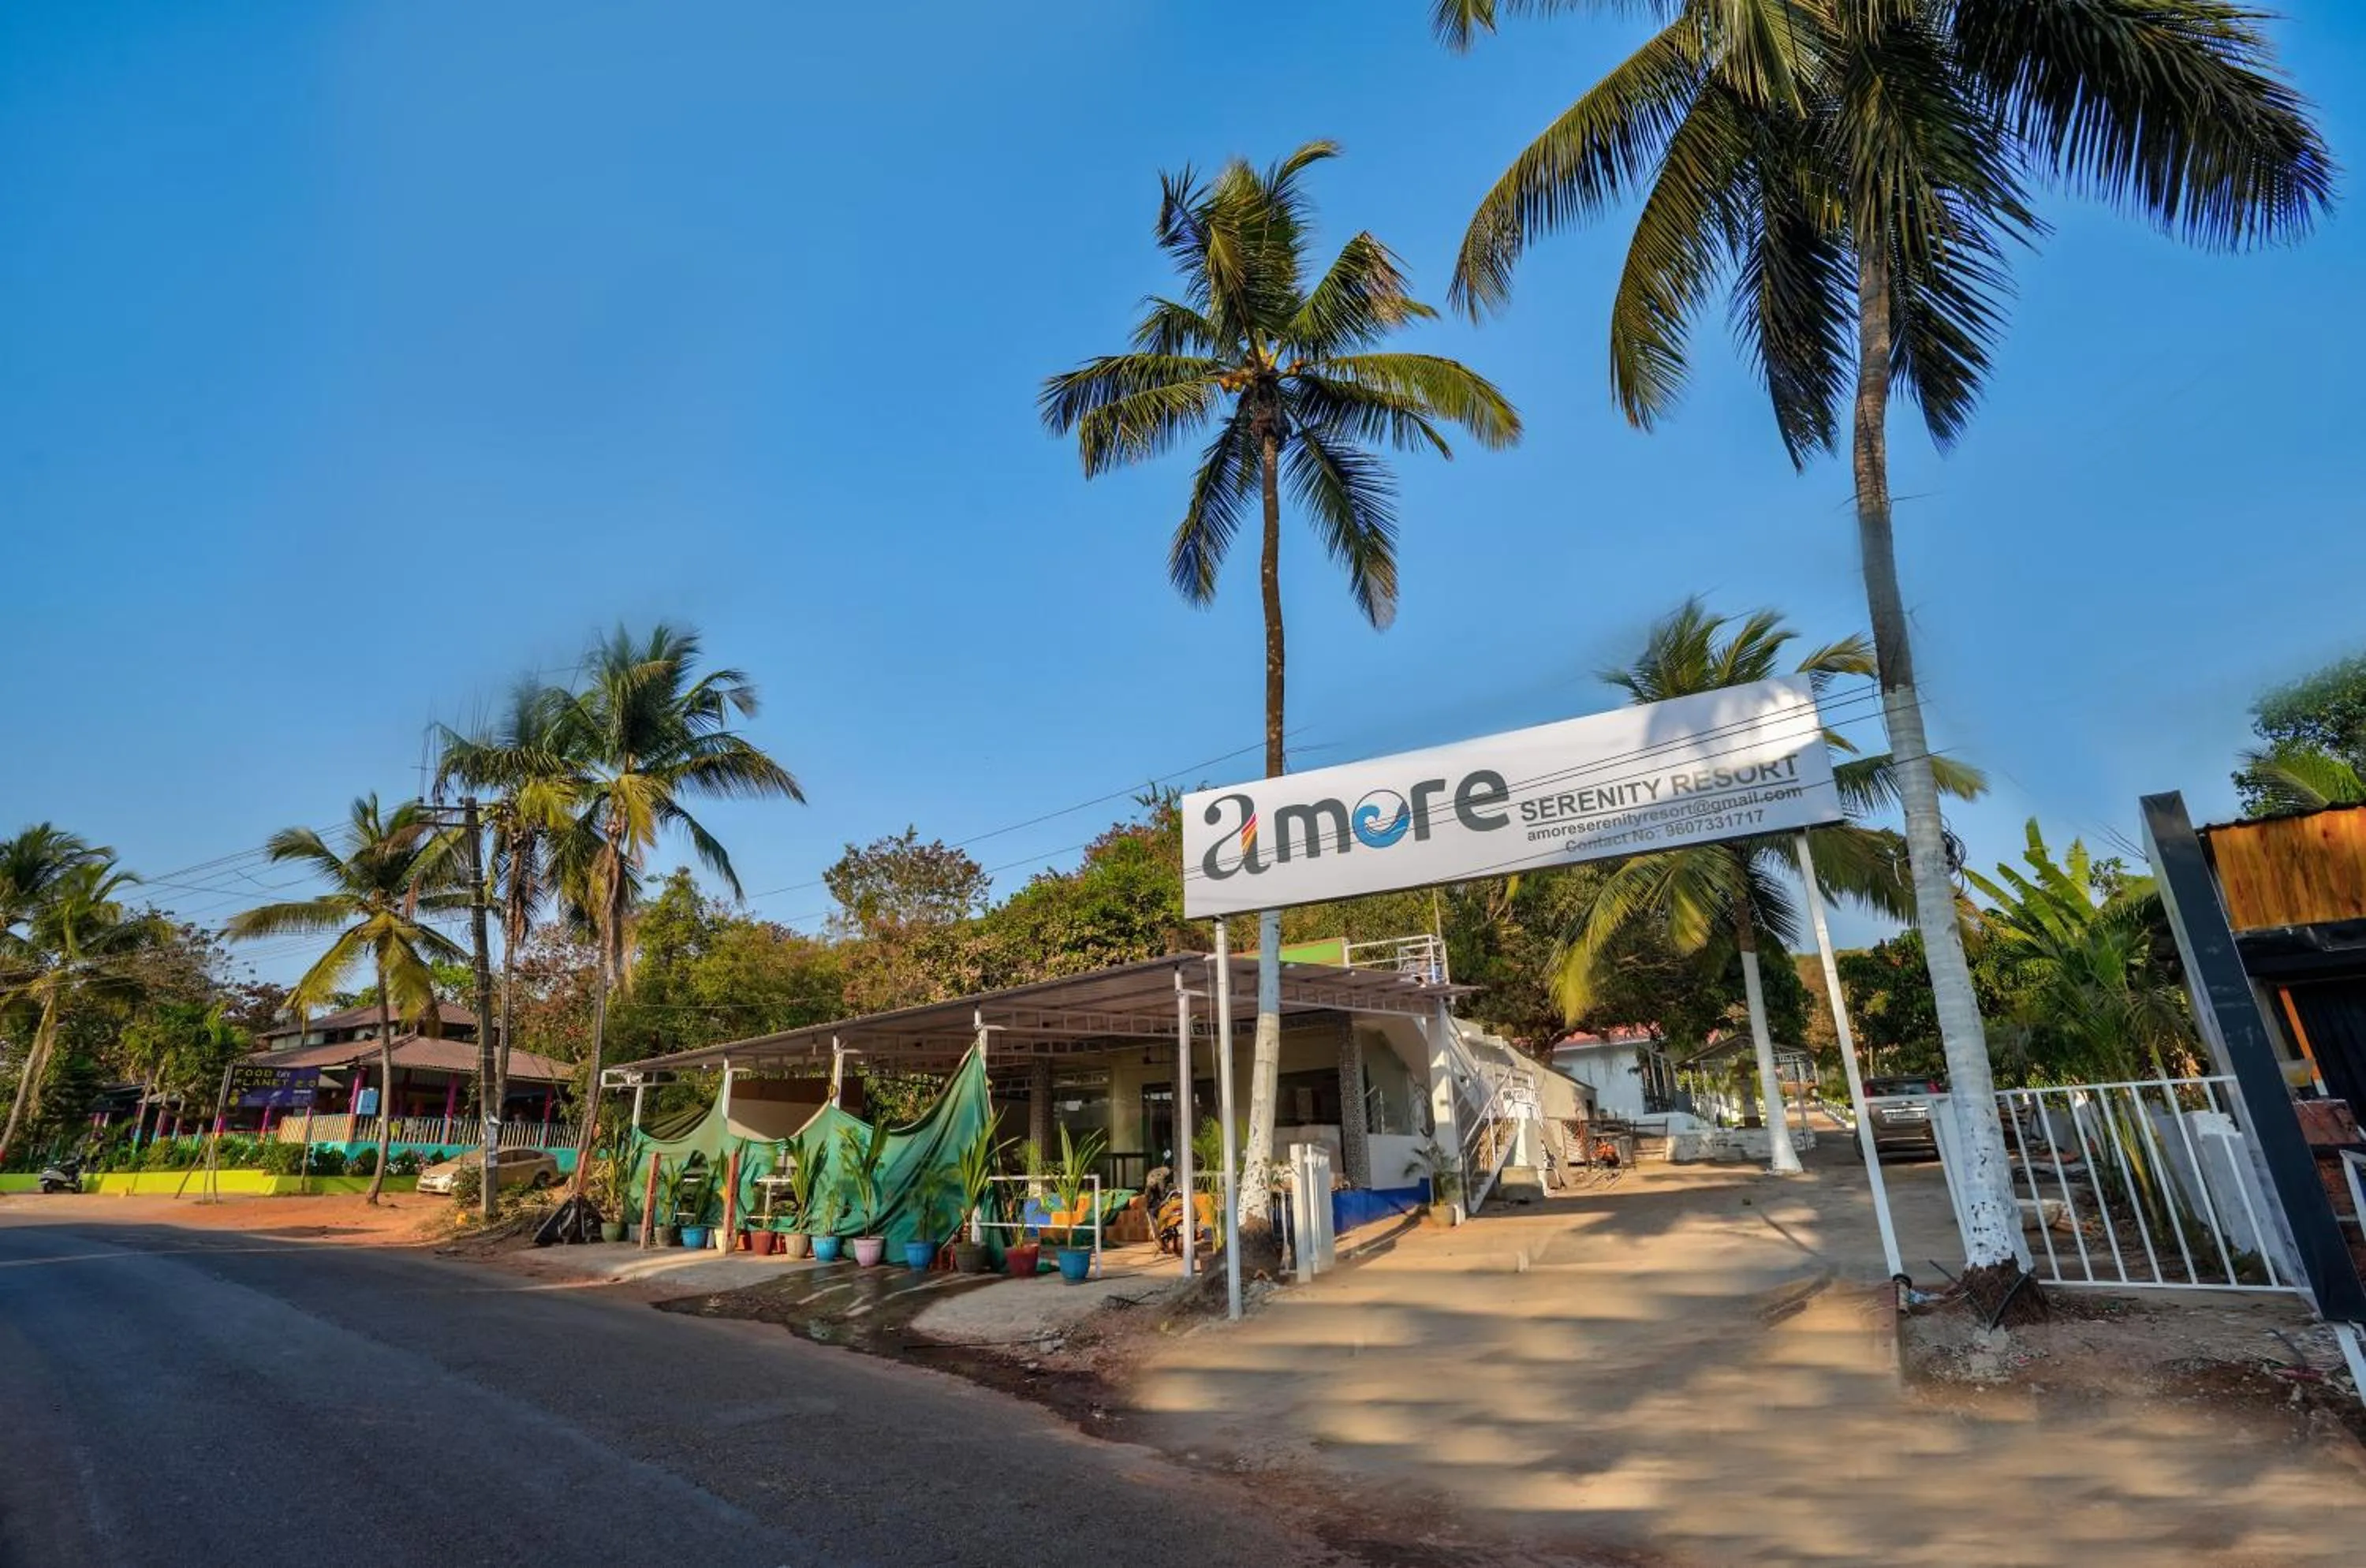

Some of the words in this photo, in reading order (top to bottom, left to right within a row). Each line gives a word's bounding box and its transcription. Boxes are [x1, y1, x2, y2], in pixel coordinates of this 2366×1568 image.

[1520, 777, 1662, 822] SERENITY
[1670, 753, 1798, 796] RESORT
[1202, 768, 1511, 881] amore
[1527, 787, 1804, 842] amoreserenityresort@gmail.com
[1566, 831, 1629, 853] Contact
[1665, 808, 1764, 838] 9607331717
[232, 1077, 289, 1086] PLANET
[234, 1068, 273, 1077] FOOD
